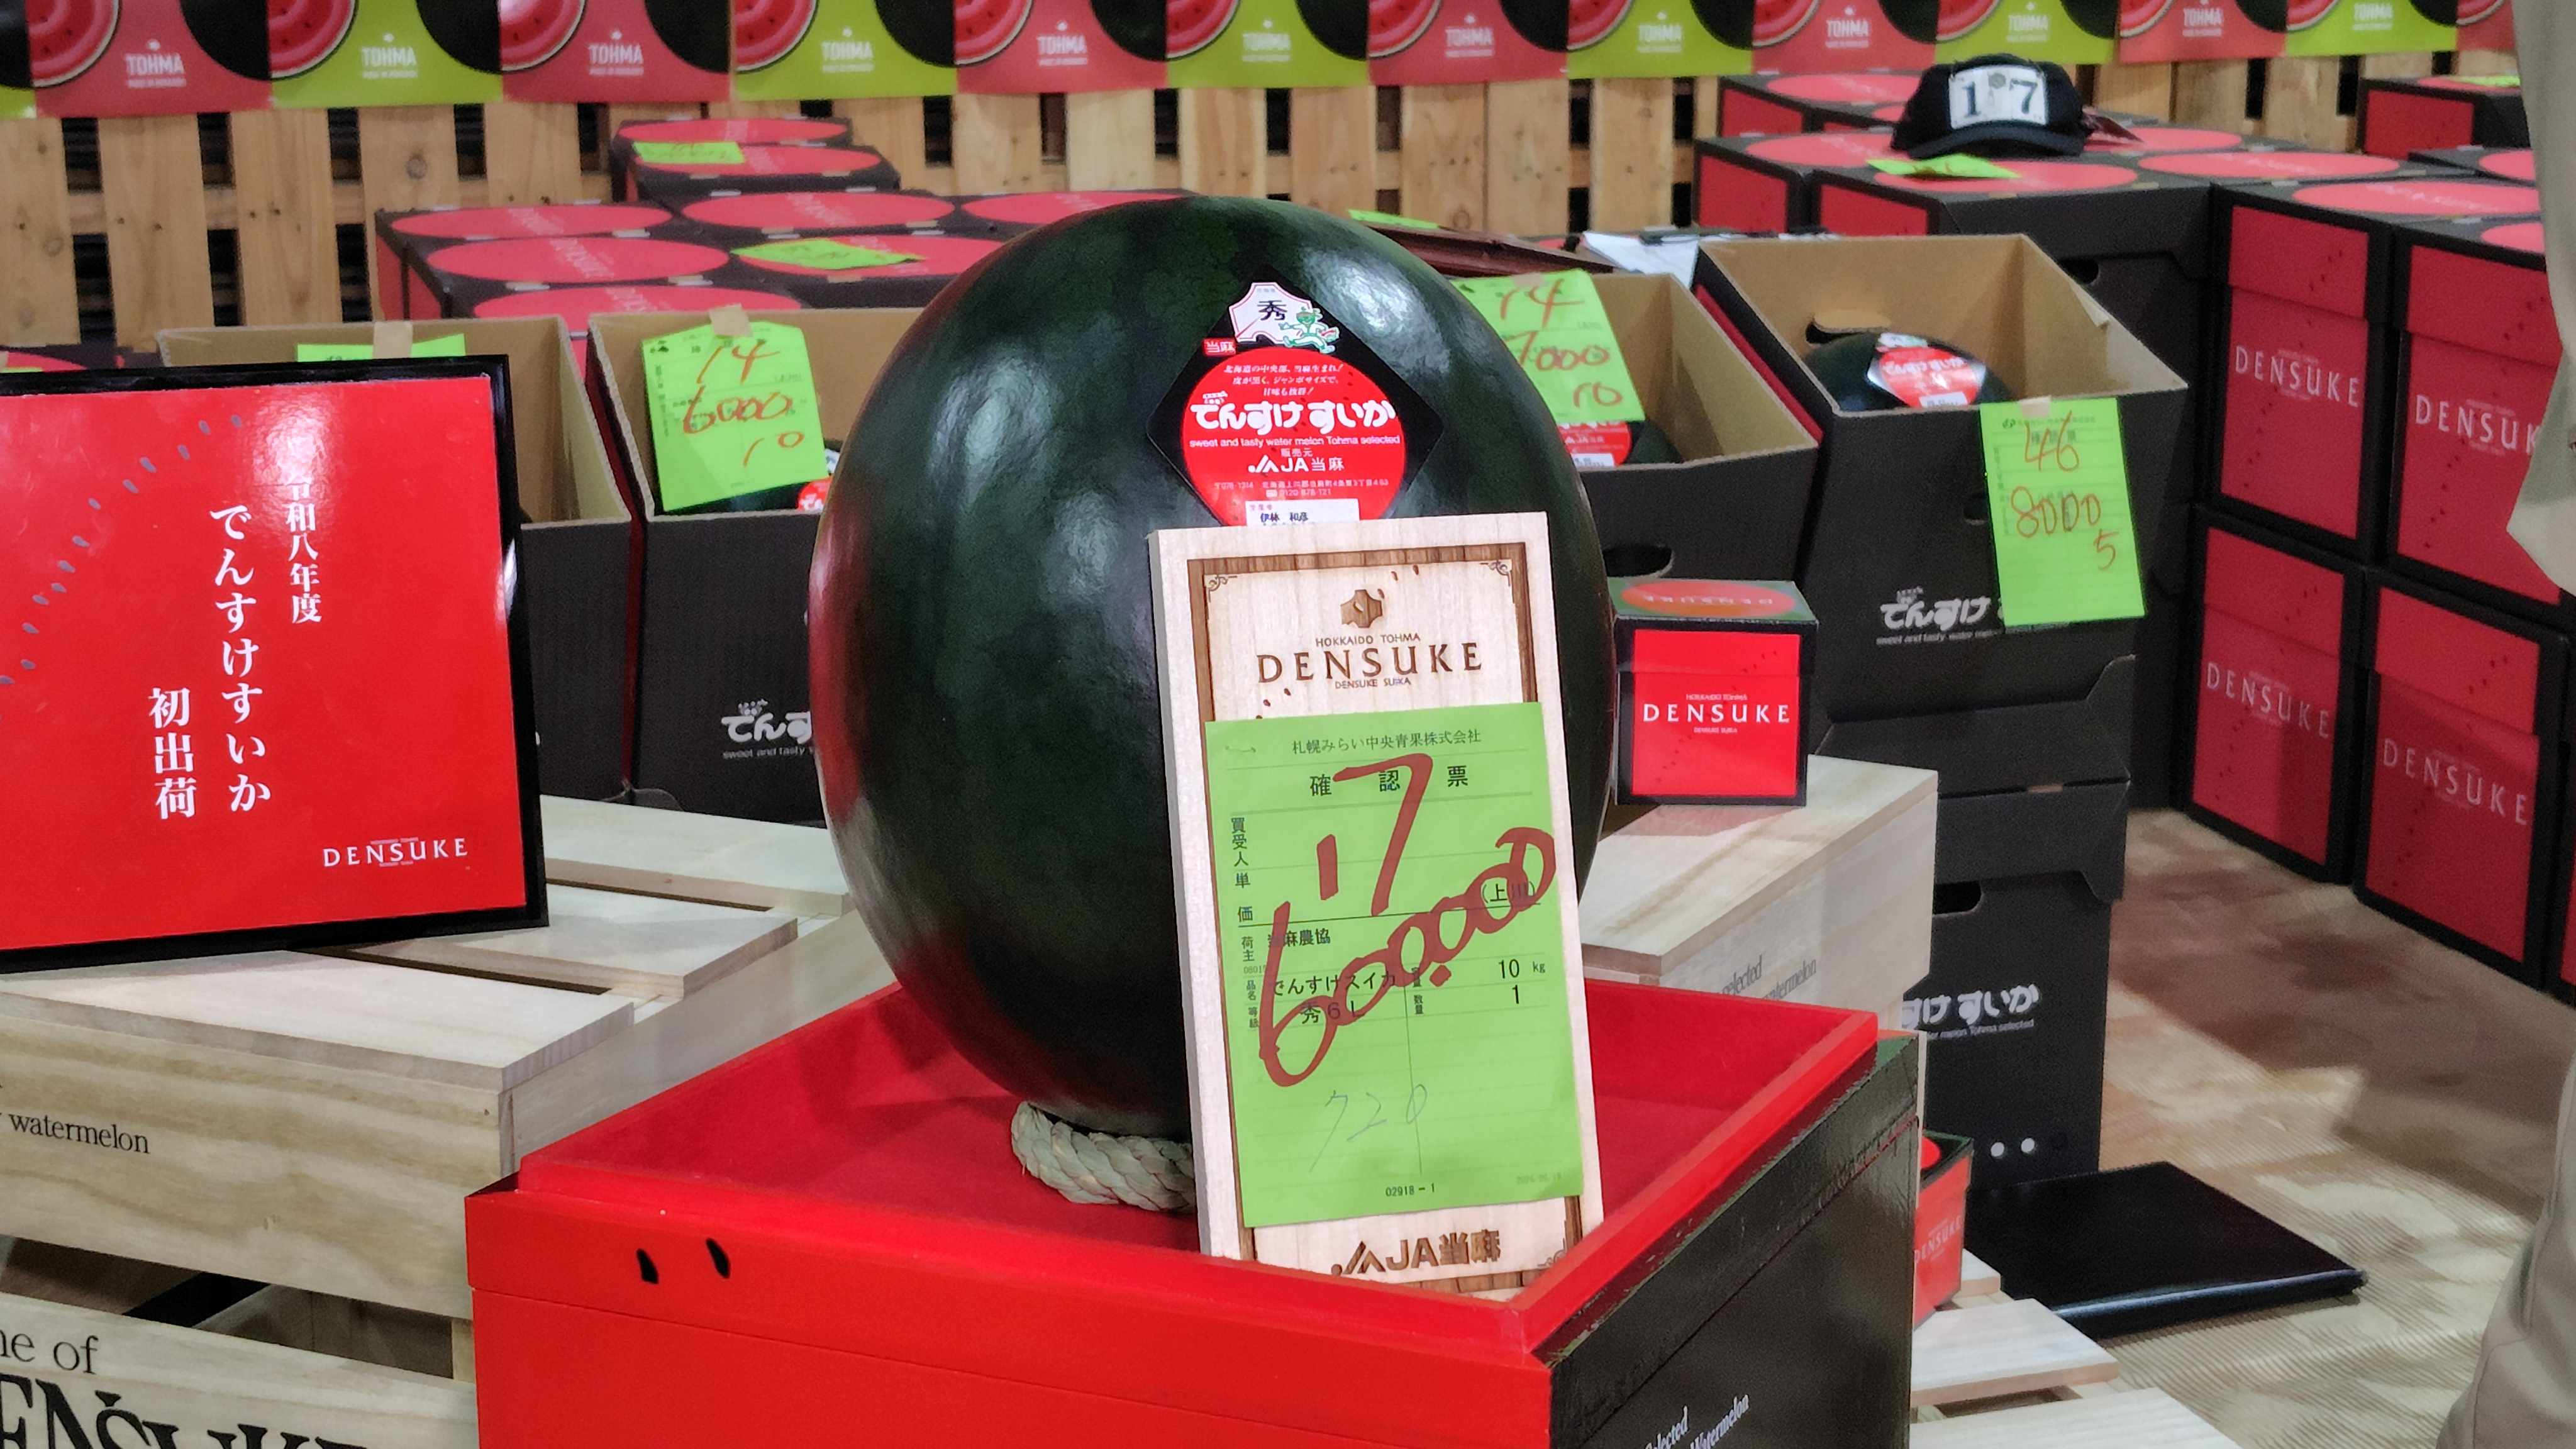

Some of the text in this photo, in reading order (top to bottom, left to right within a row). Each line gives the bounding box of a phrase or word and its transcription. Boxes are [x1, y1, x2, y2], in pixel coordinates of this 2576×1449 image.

[1036, 35, 1087, 54] TOHMA
[1826, 19, 1869, 37] TOHMA
[125, 53, 185, 74] TOHMA
[362, 47, 417, 67] TOHMA
[589, 43, 643, 64] TOHMA
[1257, 300, 1287, 320] 秀
[1500, 279, 1585, 328] 14
[696, 338, 780, 384] 14
[1206, 341, 1236, 355] 当麻
[1504, 330, 1611, 372] 7000
[2235, 344, 2360, 408] DENSUKE
[683, 385, 792, 434] 6000
[2415, 394, 2542, 454] DENSUK
[1190, 438, 1218, 447] sweet
[1221, 438, 1238, 447] and
[1241, 438, 1263, 448] tasty
[1327, 436, 1358, 445] Tohma
[1360, 435, 1400, 445] selected
[2024, 410, 2080, 472] 46
[2011, 486, 2102, 538] 8000
[2094, 528, 2119, 570] 5
[210, 505, 271, 812] でんすけすいか
[1316, 632, 1421, 648] HOKKAIDO TOHMA
[1257, 642, 1482, 684] DENSUKE
[1335, 677, 1412, 689] DENSUKE SUIKA
[1643, 703, 1790, 723] DENSUKE
[2206, 662, 2331, 739] DENSUKE
[721, 699, 812, 745] でんす
[1292, 728, 1482, 755] 札幌みらい中央青果株式会社
[148, 687, 197, 819] 初出荷
[2384, 738, 2528, 826] DENSUKE
[324, 838, 469, 868] DENSUKE
[1499, 958, 1546, 979] 10 kg
[1512, 984, 1519, 1005] 1
[1957, 984, 2040, 1025] すいか
[8, 1114, 150, 1155] watermelon
[53, 1335, 99, 1375] of
[1645, 1405, 1689, 1449] lected
